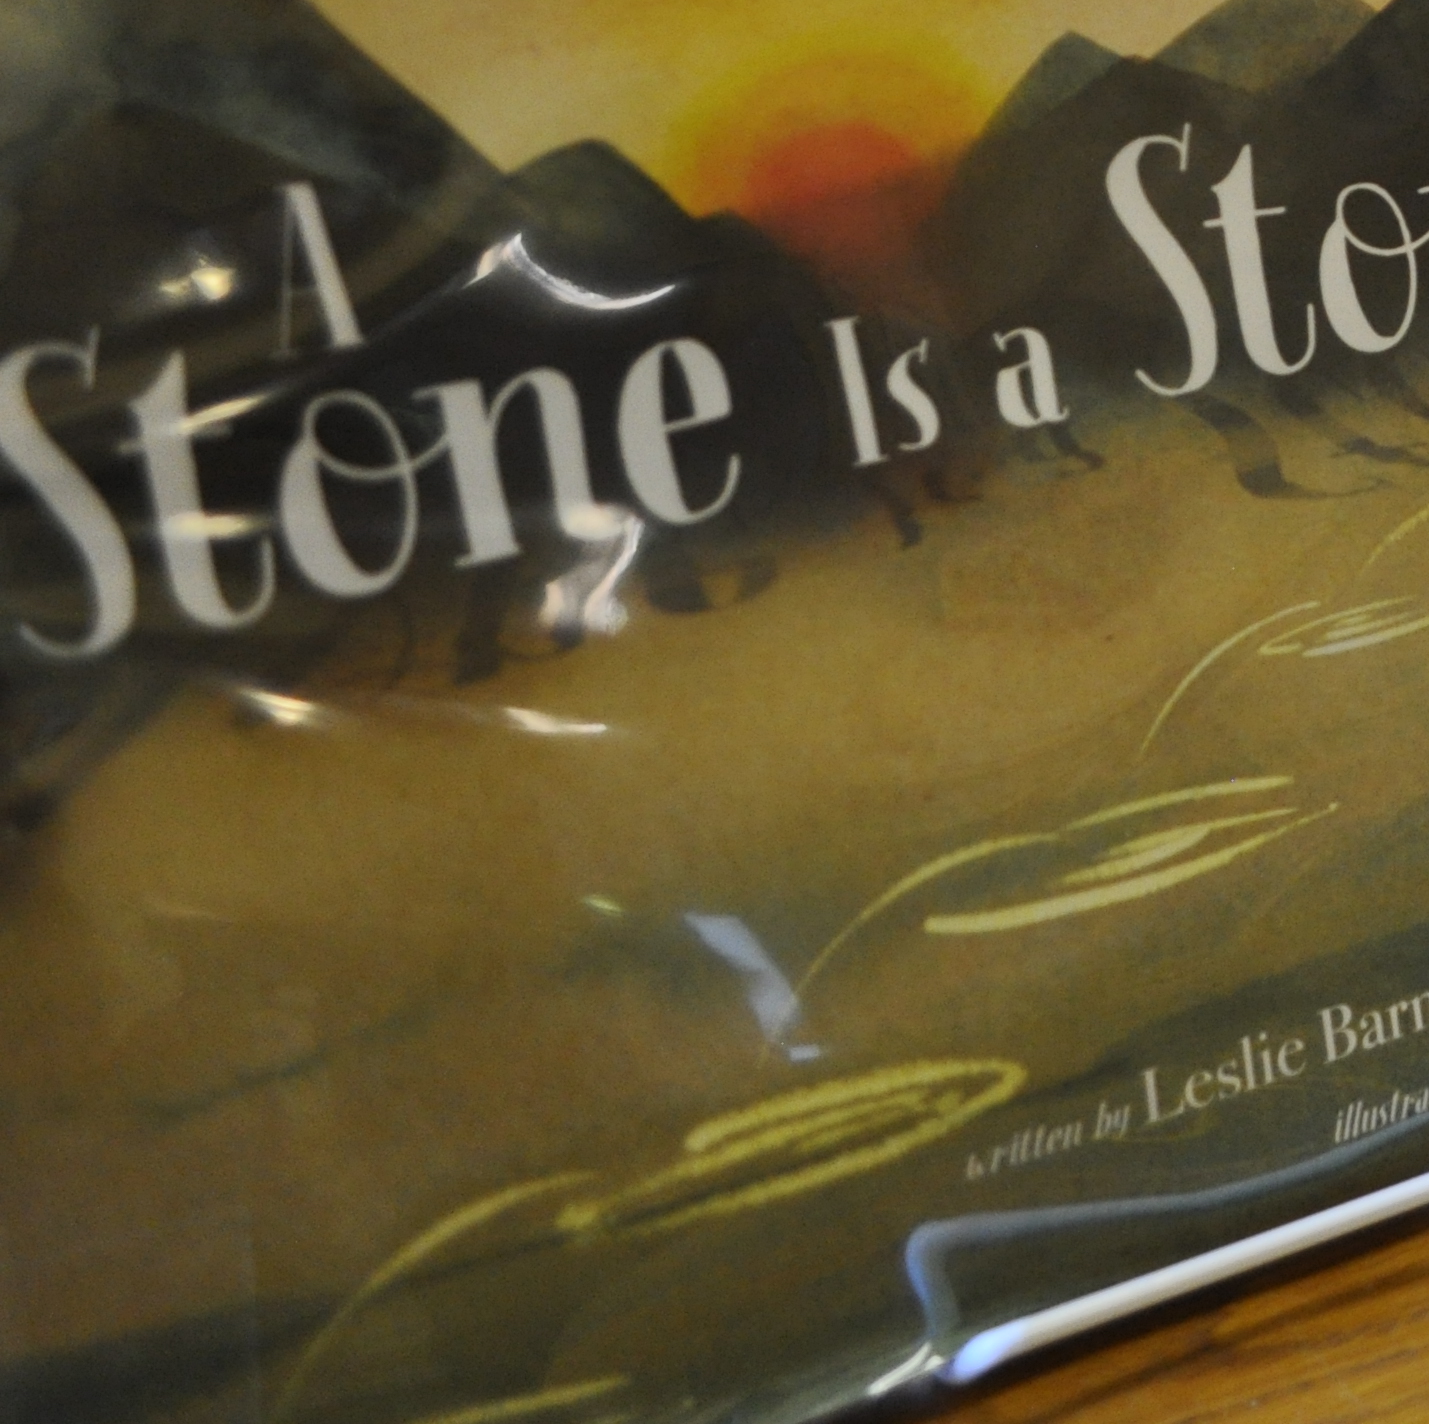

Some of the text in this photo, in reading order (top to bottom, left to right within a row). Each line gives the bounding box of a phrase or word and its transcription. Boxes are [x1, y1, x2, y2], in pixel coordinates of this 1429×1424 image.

[270, 181, 367, 358] A
[0, 324, 742, 661] Stone
[825, 315, 942, 466] Is
[994, 326, 1070, 429] a
[1094, 1100, 1131, 1141] by
[1140, 1030, 1309, 1127] Leslie
